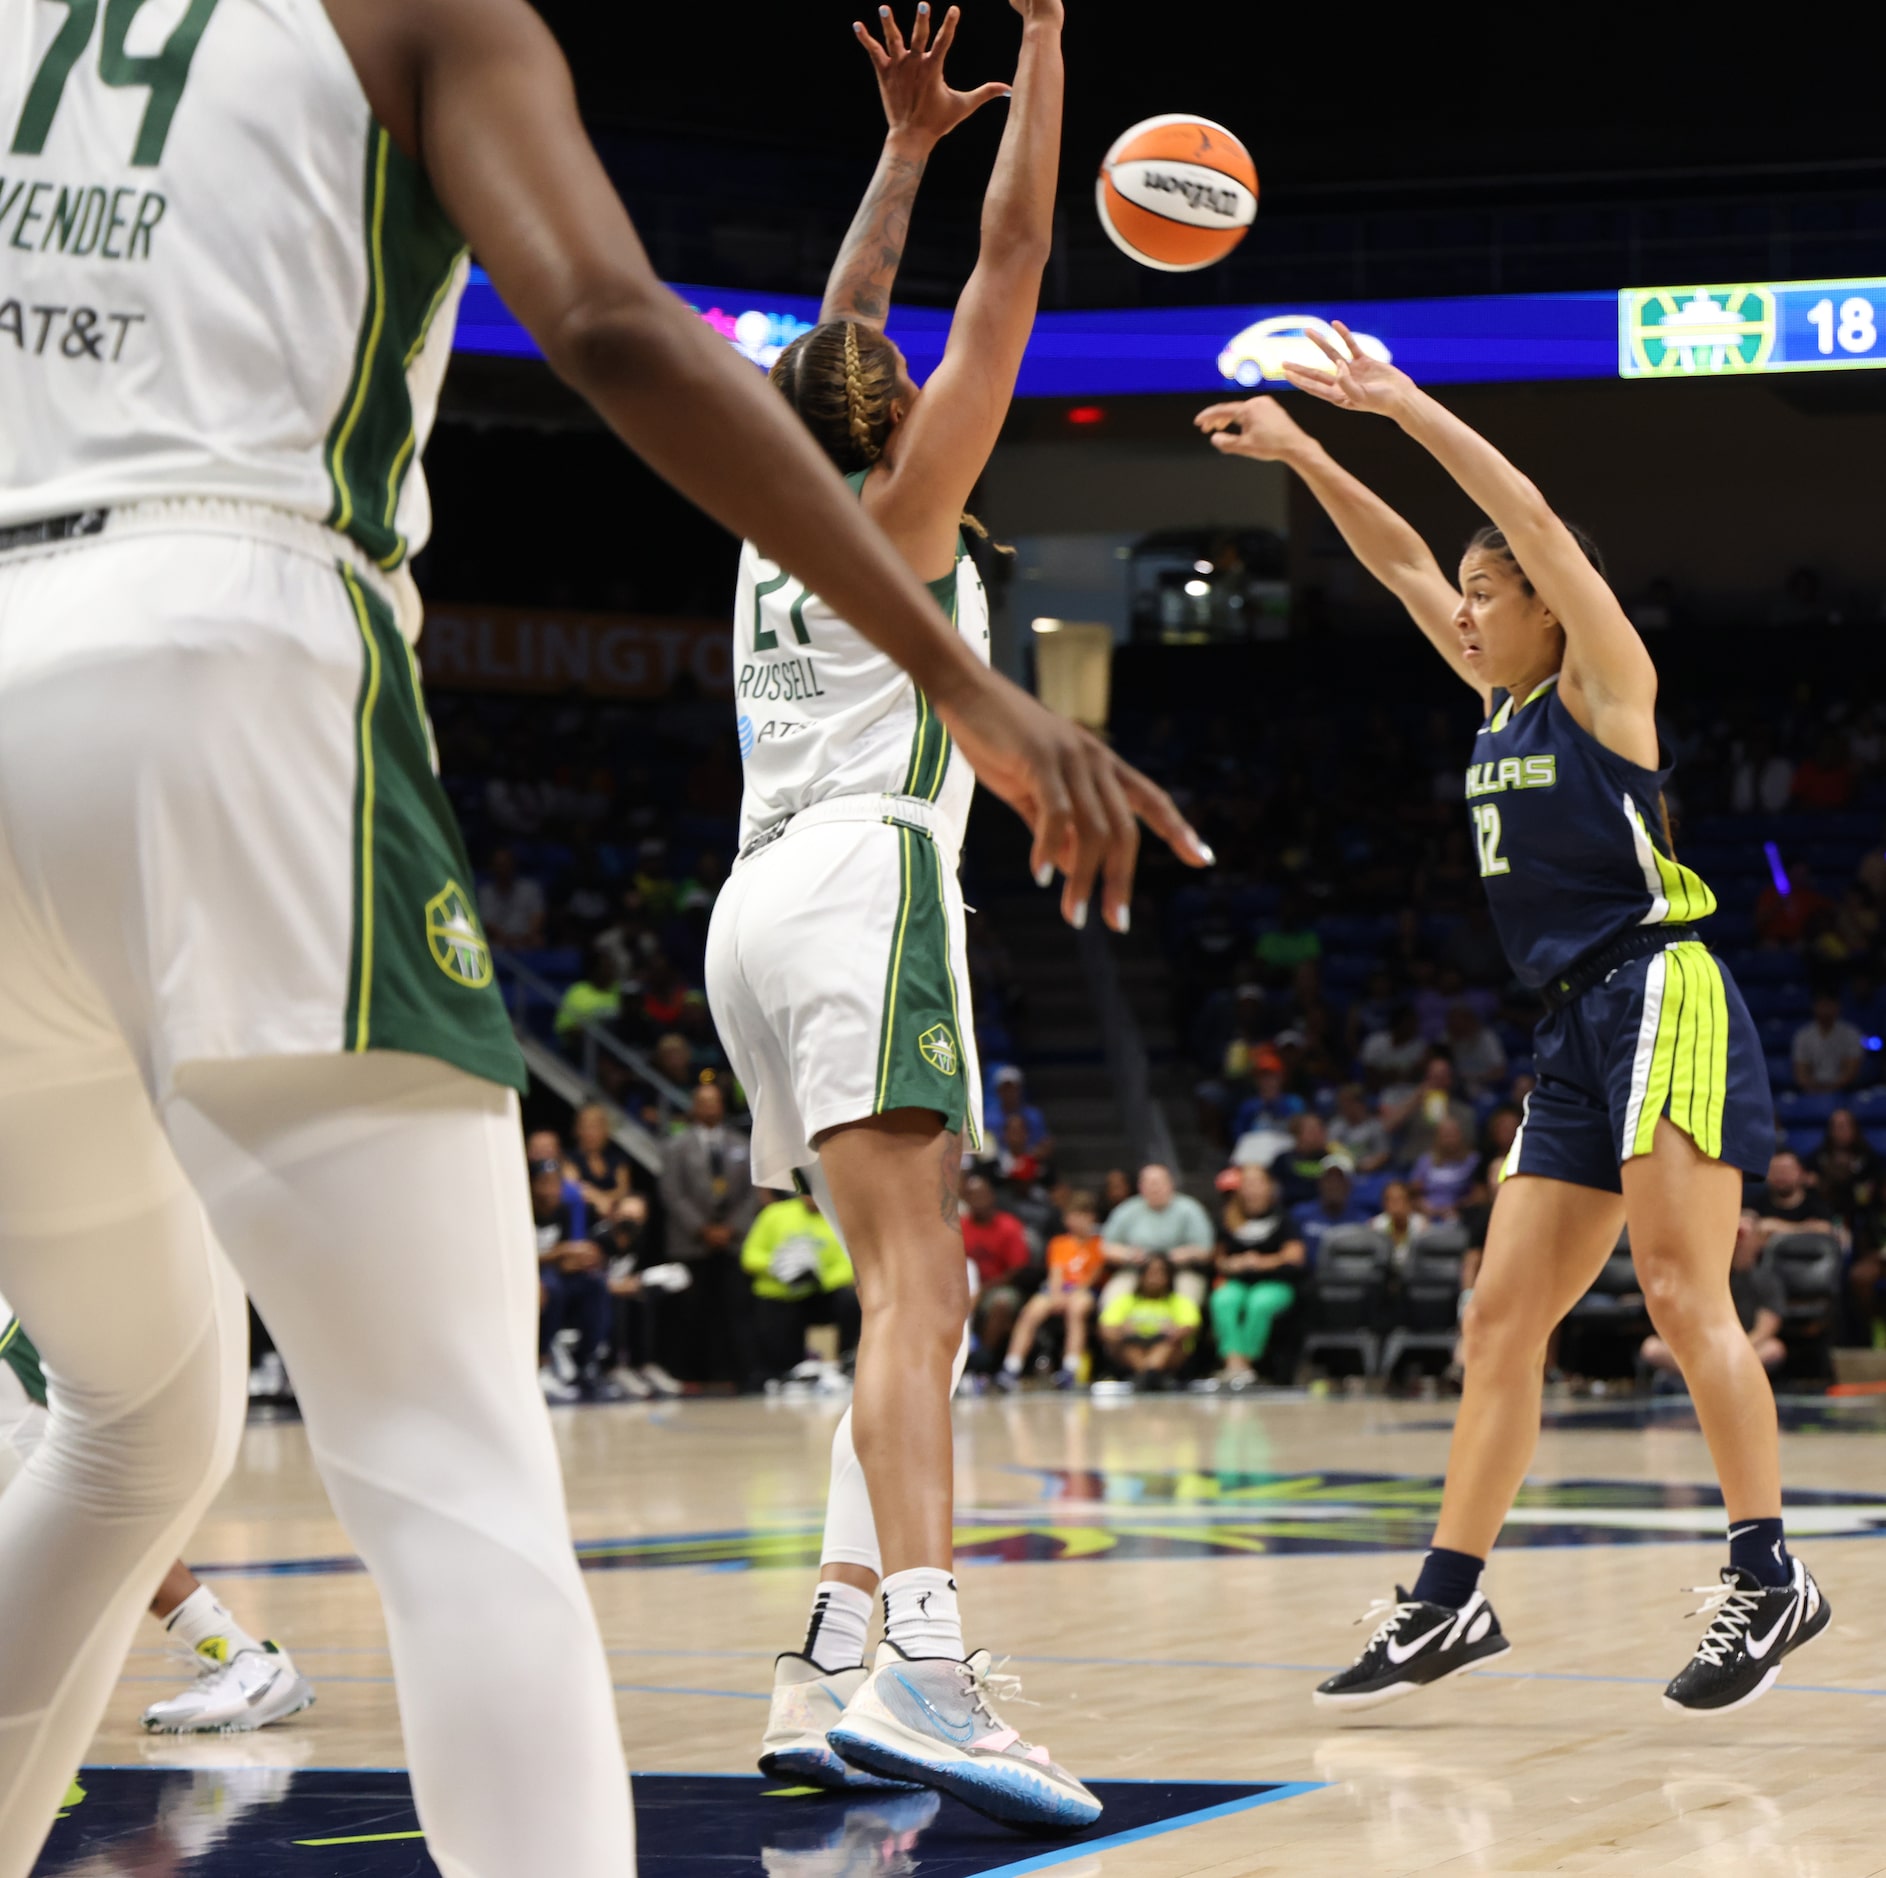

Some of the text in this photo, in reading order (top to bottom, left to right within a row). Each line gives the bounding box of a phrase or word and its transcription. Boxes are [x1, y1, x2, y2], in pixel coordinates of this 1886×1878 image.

[1143, 170, 1239, 218] Wilson
[0, 297, 146, 362] AT&T
[1806, 297, 1877, 354] 18
[737, 657, 825, 701] RUSSELL
[1472, 802, 1511, 877] 12
